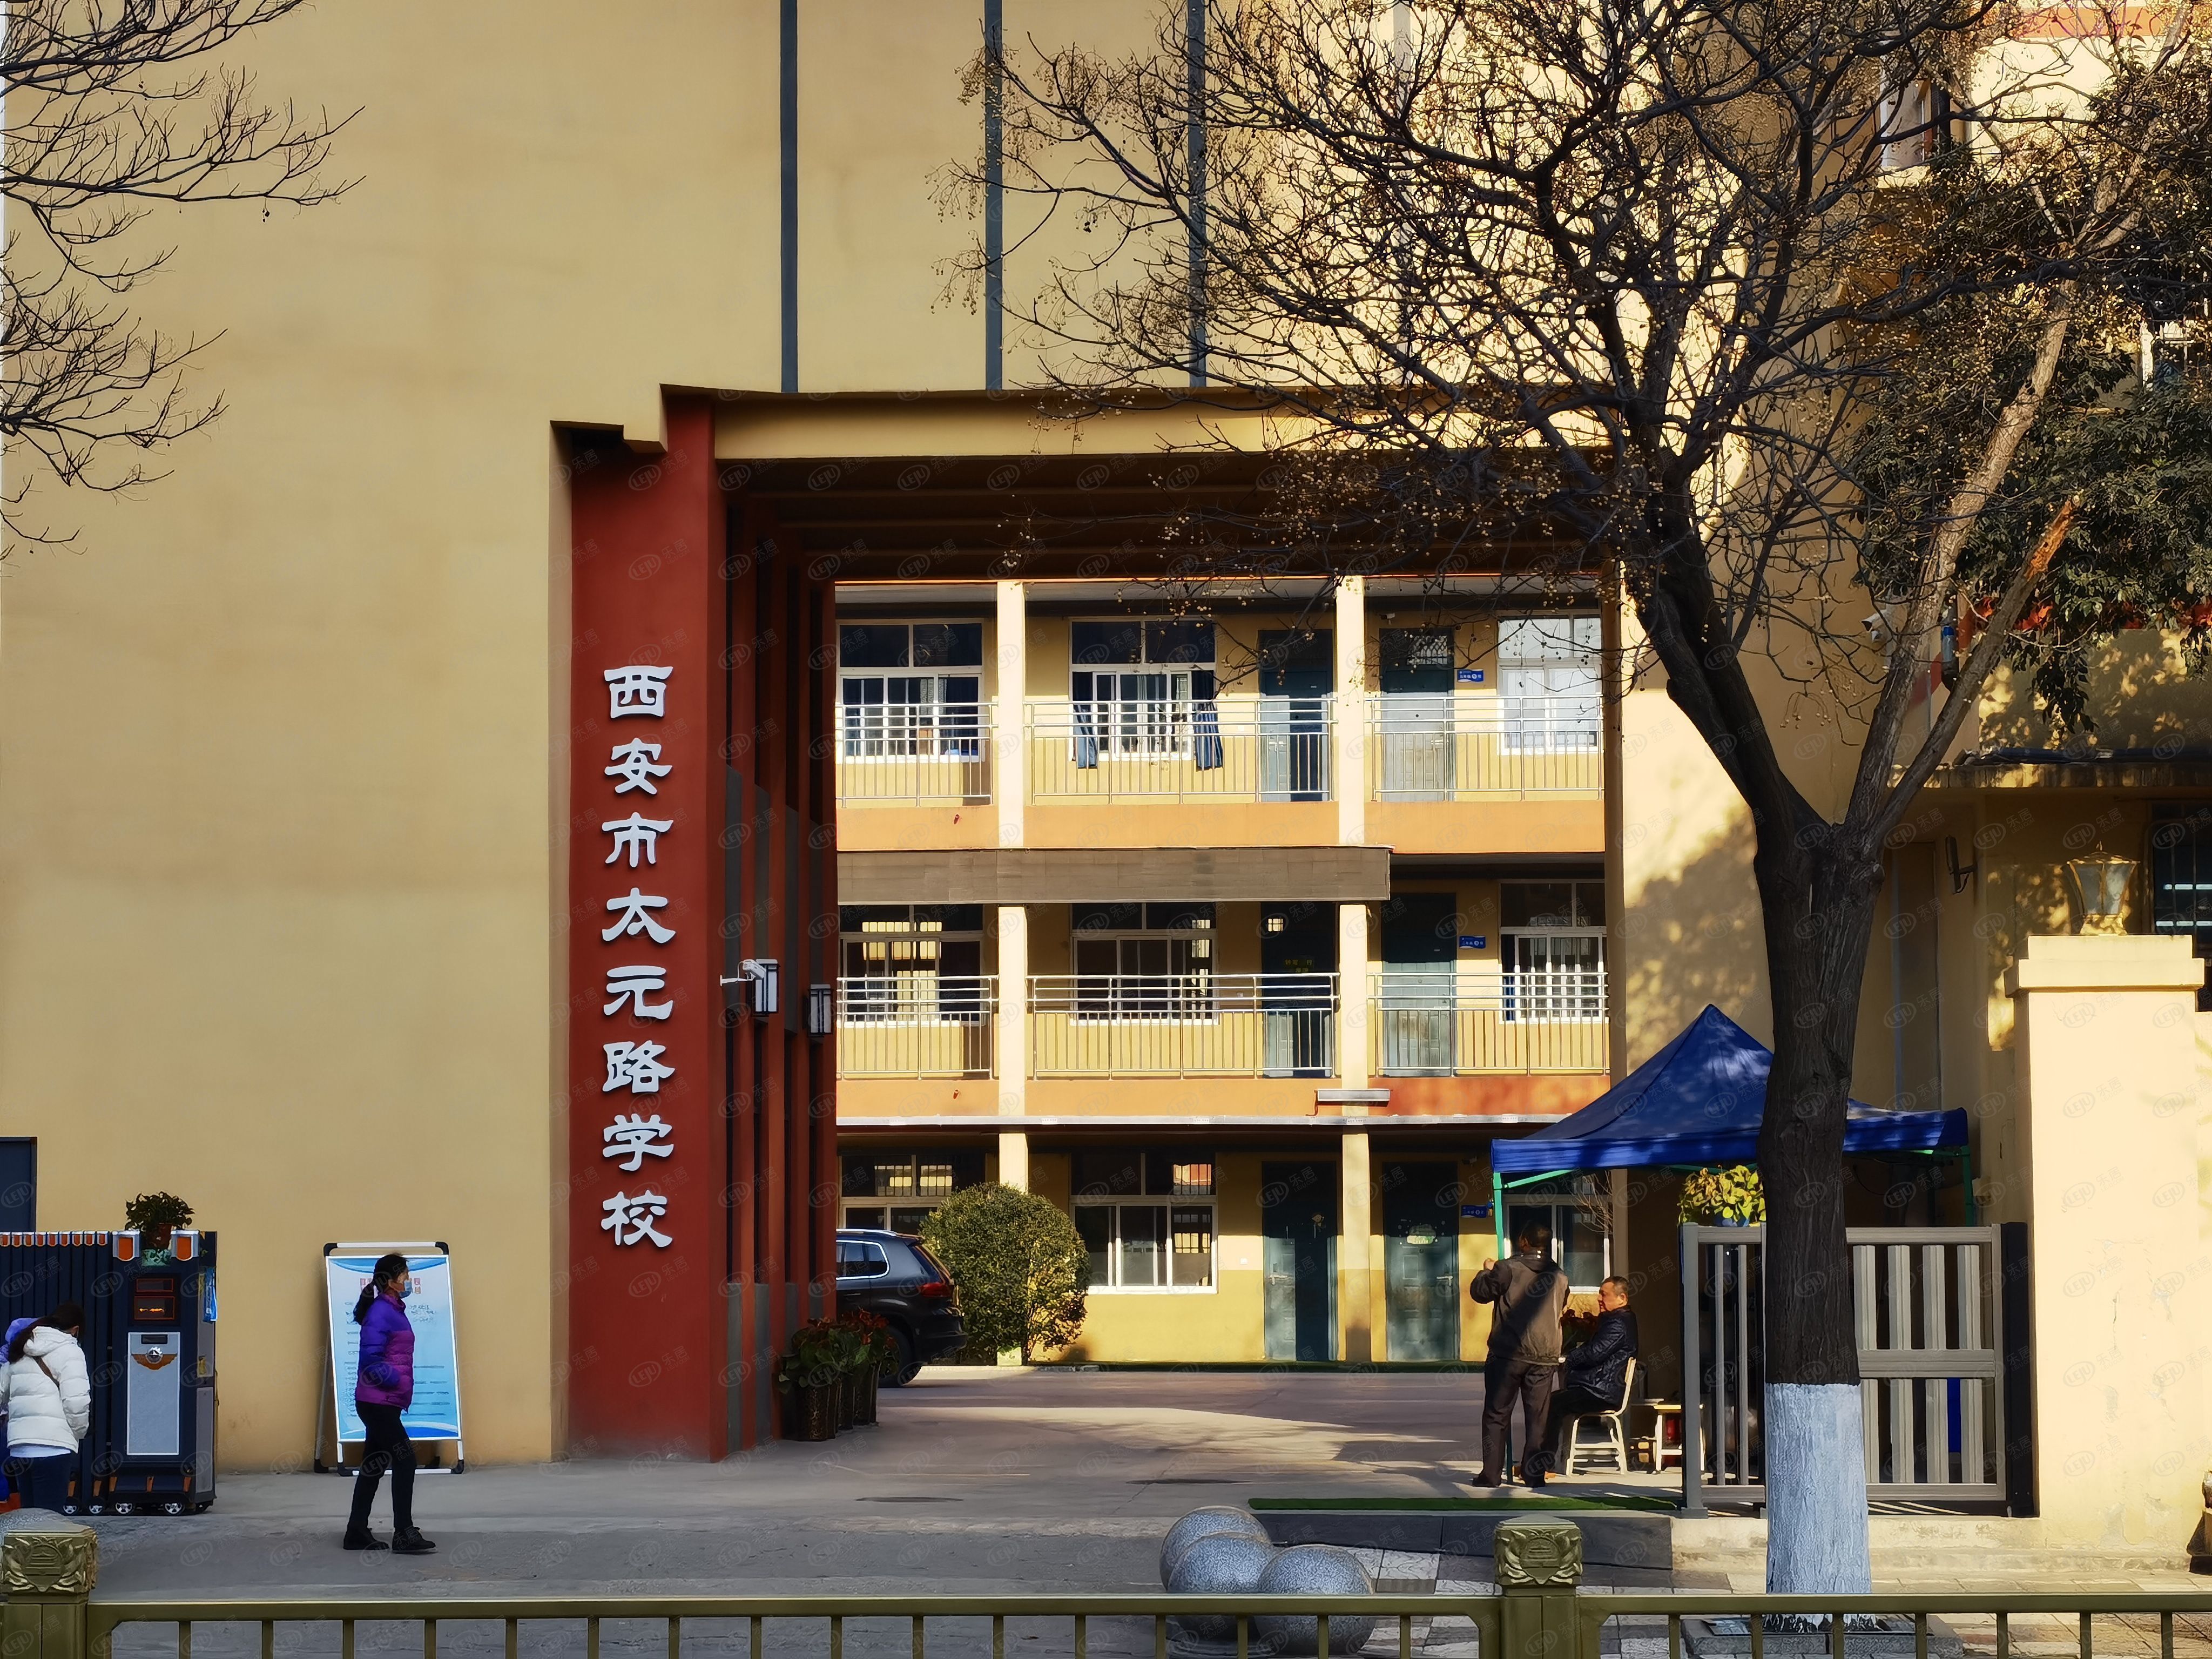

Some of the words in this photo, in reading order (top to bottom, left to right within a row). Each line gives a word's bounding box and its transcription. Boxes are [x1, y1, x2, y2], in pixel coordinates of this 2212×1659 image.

[601, 666, 676, 1247] 西安市太元路学校
